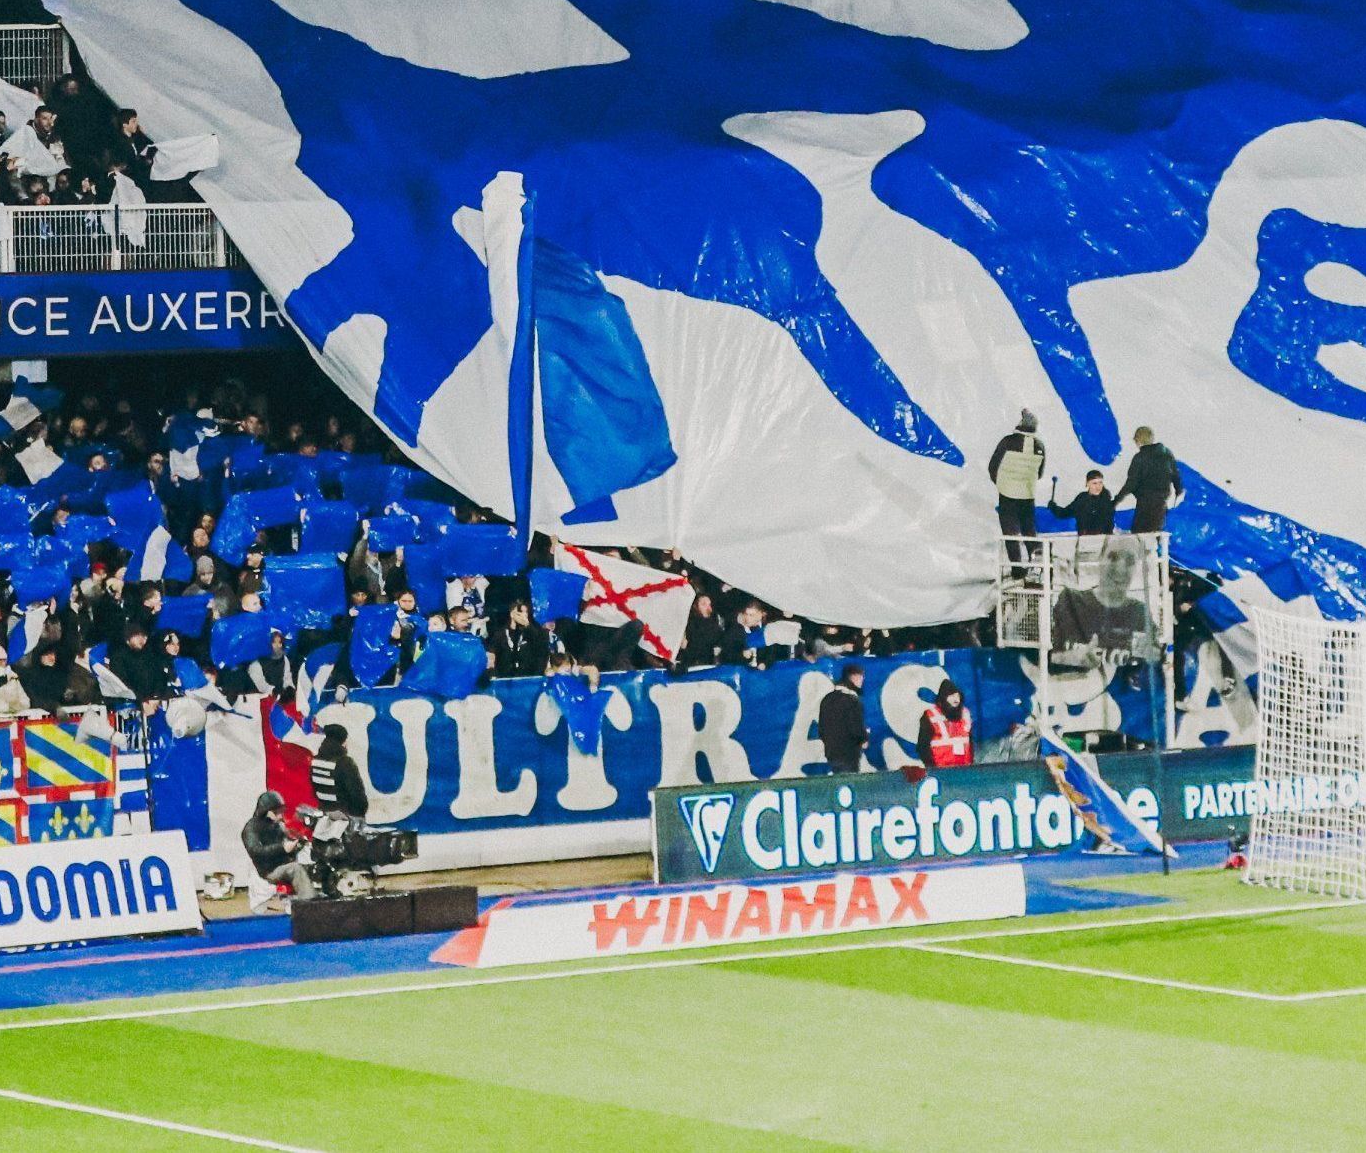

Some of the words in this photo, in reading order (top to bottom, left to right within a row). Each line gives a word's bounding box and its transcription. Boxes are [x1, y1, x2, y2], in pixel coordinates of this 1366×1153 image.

[89, 290, 286, 335] AUXERR
[742, 775, 1161, 872] Clairefontae
[587, 872, 928, 951] WINAMAX
